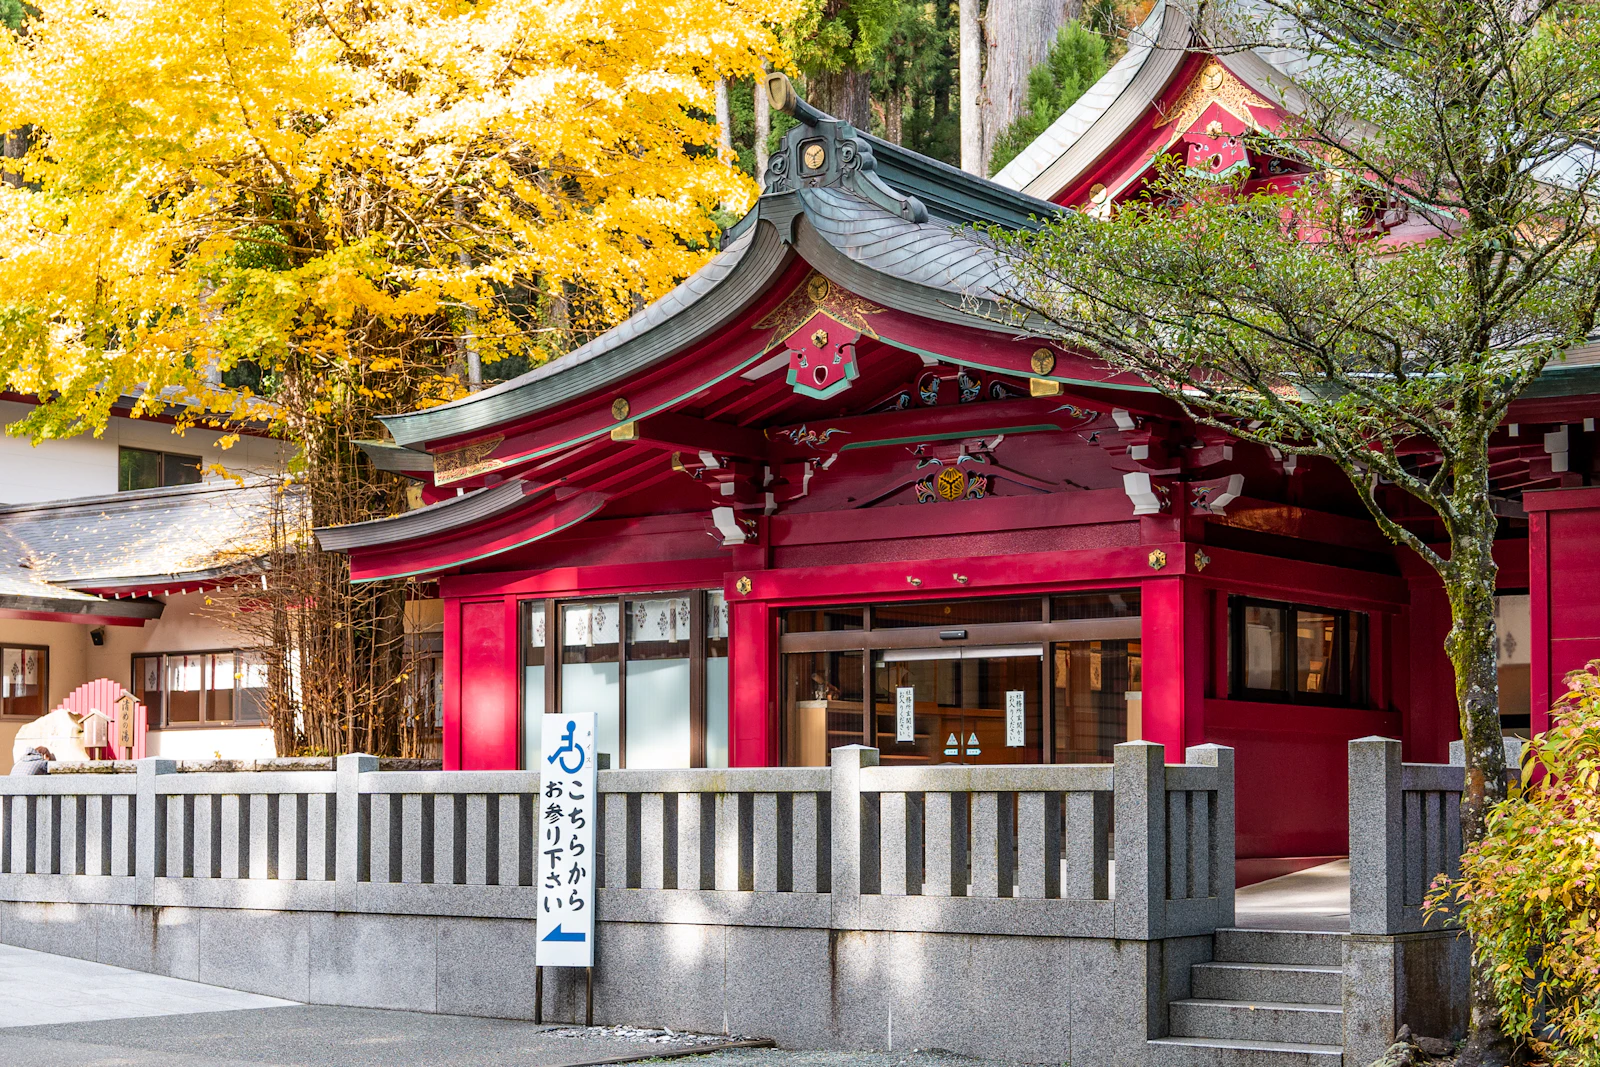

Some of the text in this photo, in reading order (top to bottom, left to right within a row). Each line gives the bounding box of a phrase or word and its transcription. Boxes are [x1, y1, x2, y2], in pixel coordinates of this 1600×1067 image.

[543, 780, 565, 913] お参り下さい
[567, 780, 587, 912] こちらから
